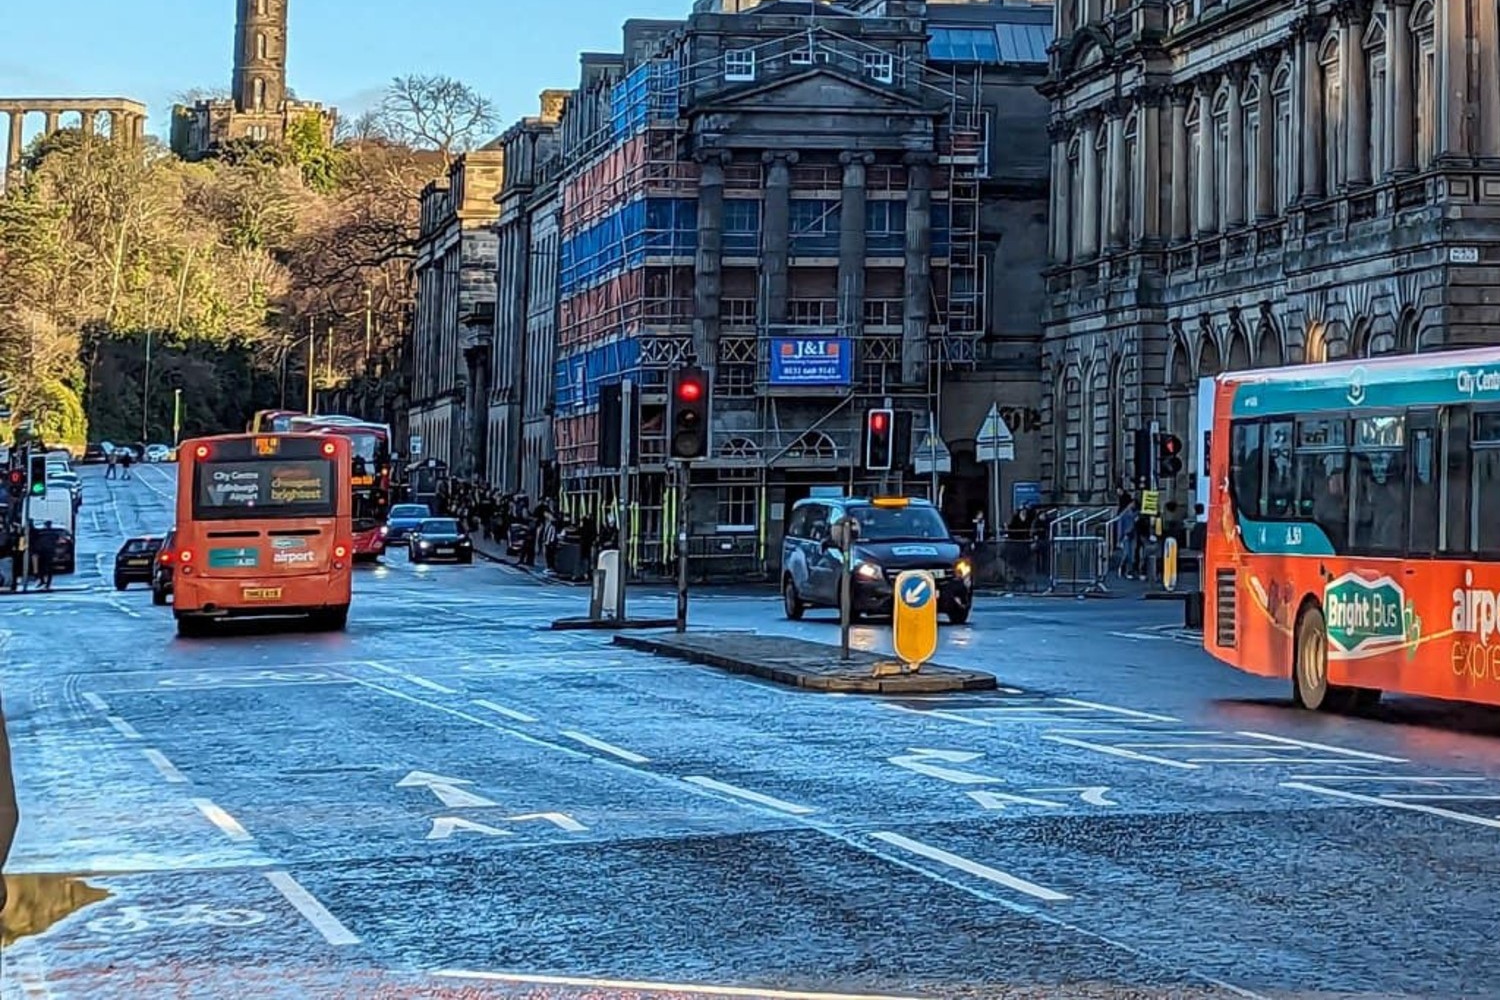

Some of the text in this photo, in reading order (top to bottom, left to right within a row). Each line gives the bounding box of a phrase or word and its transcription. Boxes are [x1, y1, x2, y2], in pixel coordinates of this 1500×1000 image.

[794, 341, 825, 358] J&I
[1457, 370, 1476, 397] City
[274, 550, 315, 565] airport
[1328, 592, 1398, 635] Bright Bus
